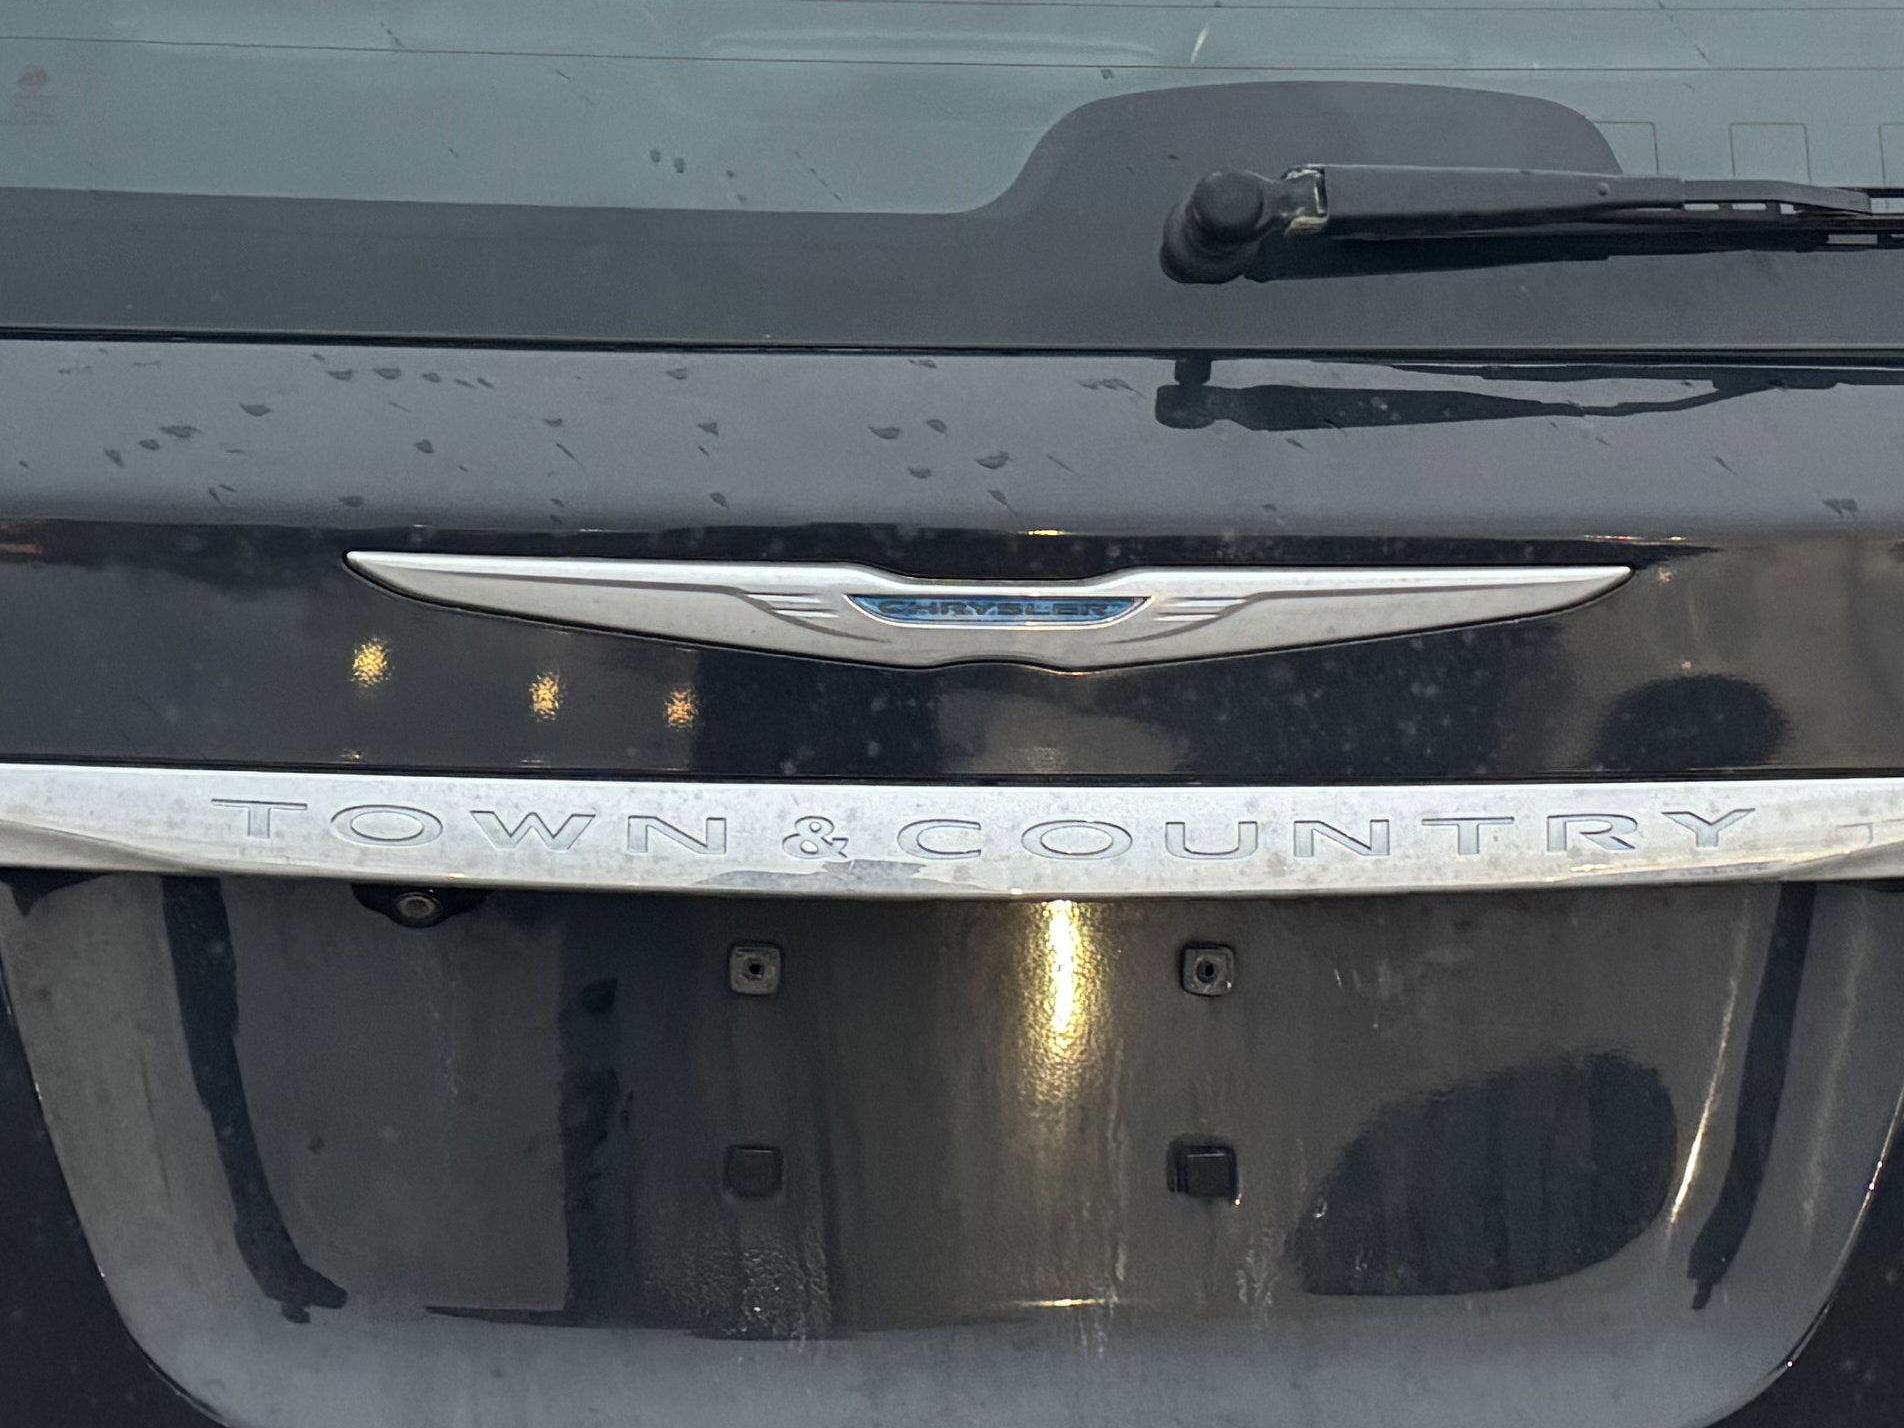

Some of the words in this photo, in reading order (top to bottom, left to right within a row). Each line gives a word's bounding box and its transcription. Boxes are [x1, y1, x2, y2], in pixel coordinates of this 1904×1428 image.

[878, 600, 1106, 616] CHRYSLER
[211, 798, 727, 855] TOWN
[782, 815, 849, 860] &
[896, 798, 1756, 861] COUNTRY
